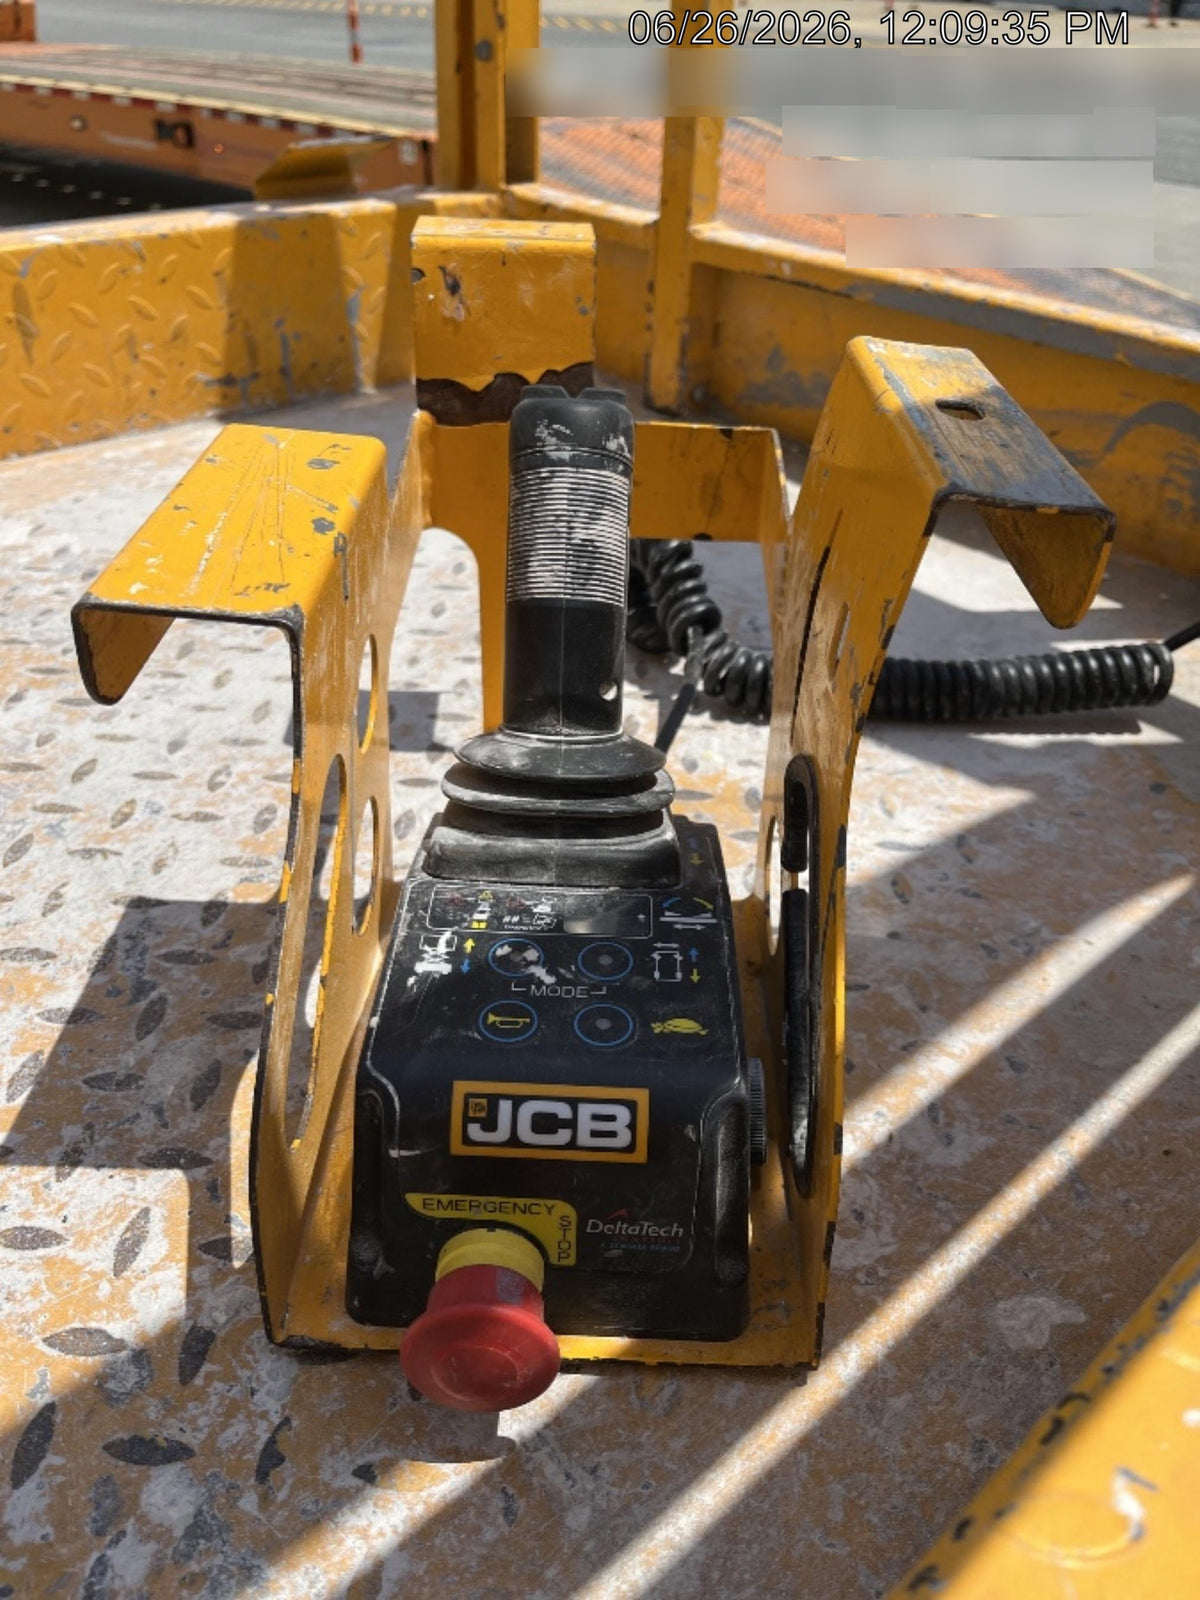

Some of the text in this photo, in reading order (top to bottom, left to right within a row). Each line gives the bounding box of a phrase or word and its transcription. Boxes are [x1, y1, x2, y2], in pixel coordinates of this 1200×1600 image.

[531, 984, 589, 998] MODE
[467, 1099, 632, 1148] JCB
[422, 1198, 556, 1216] EMERGENCY
[586, 1219, 684, 1237] DeltaTech
[557, 1215, 572, 1263] STOP
